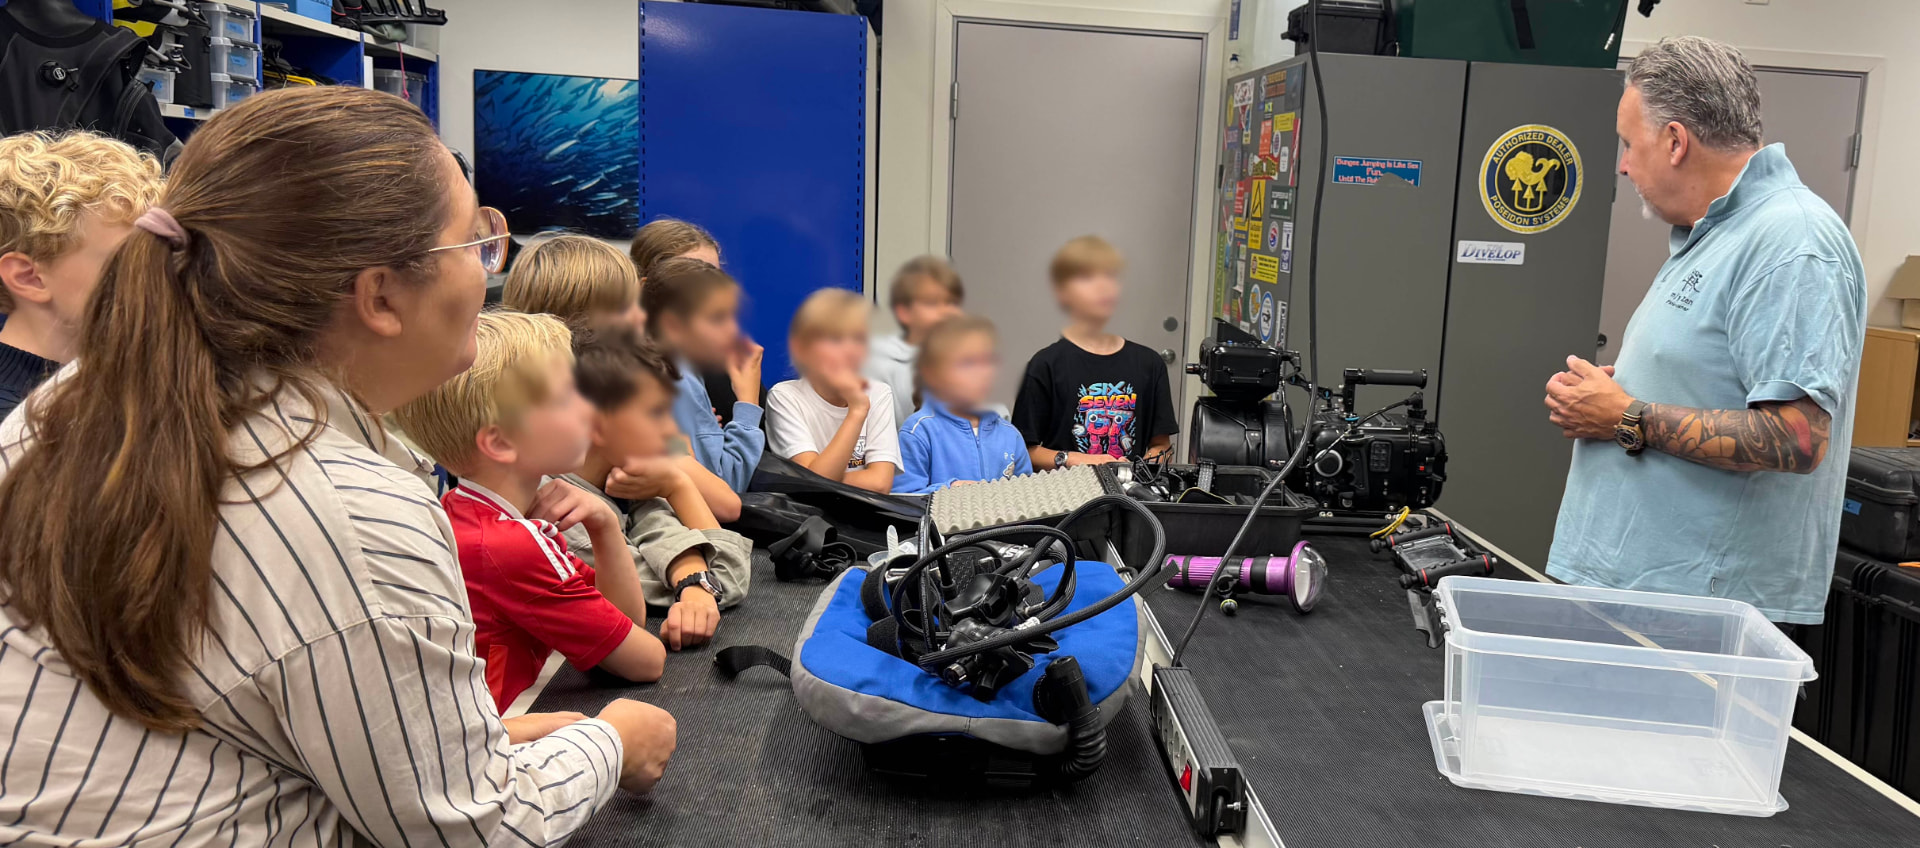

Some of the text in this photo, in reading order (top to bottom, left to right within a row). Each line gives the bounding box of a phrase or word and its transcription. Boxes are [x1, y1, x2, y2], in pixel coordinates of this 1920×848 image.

[1492, 132, 1574, 167] AUTHORIZED DEALER
[1361, 160, 1386, 169] Jumping
[1355, 176, 1366, 184] The
[1490, 194, 1570, 226] POSEIDON SYSTEMS
[1088, 381, 1126, 396] SIX
[1079, 393, 1138, 412] SEVEN
